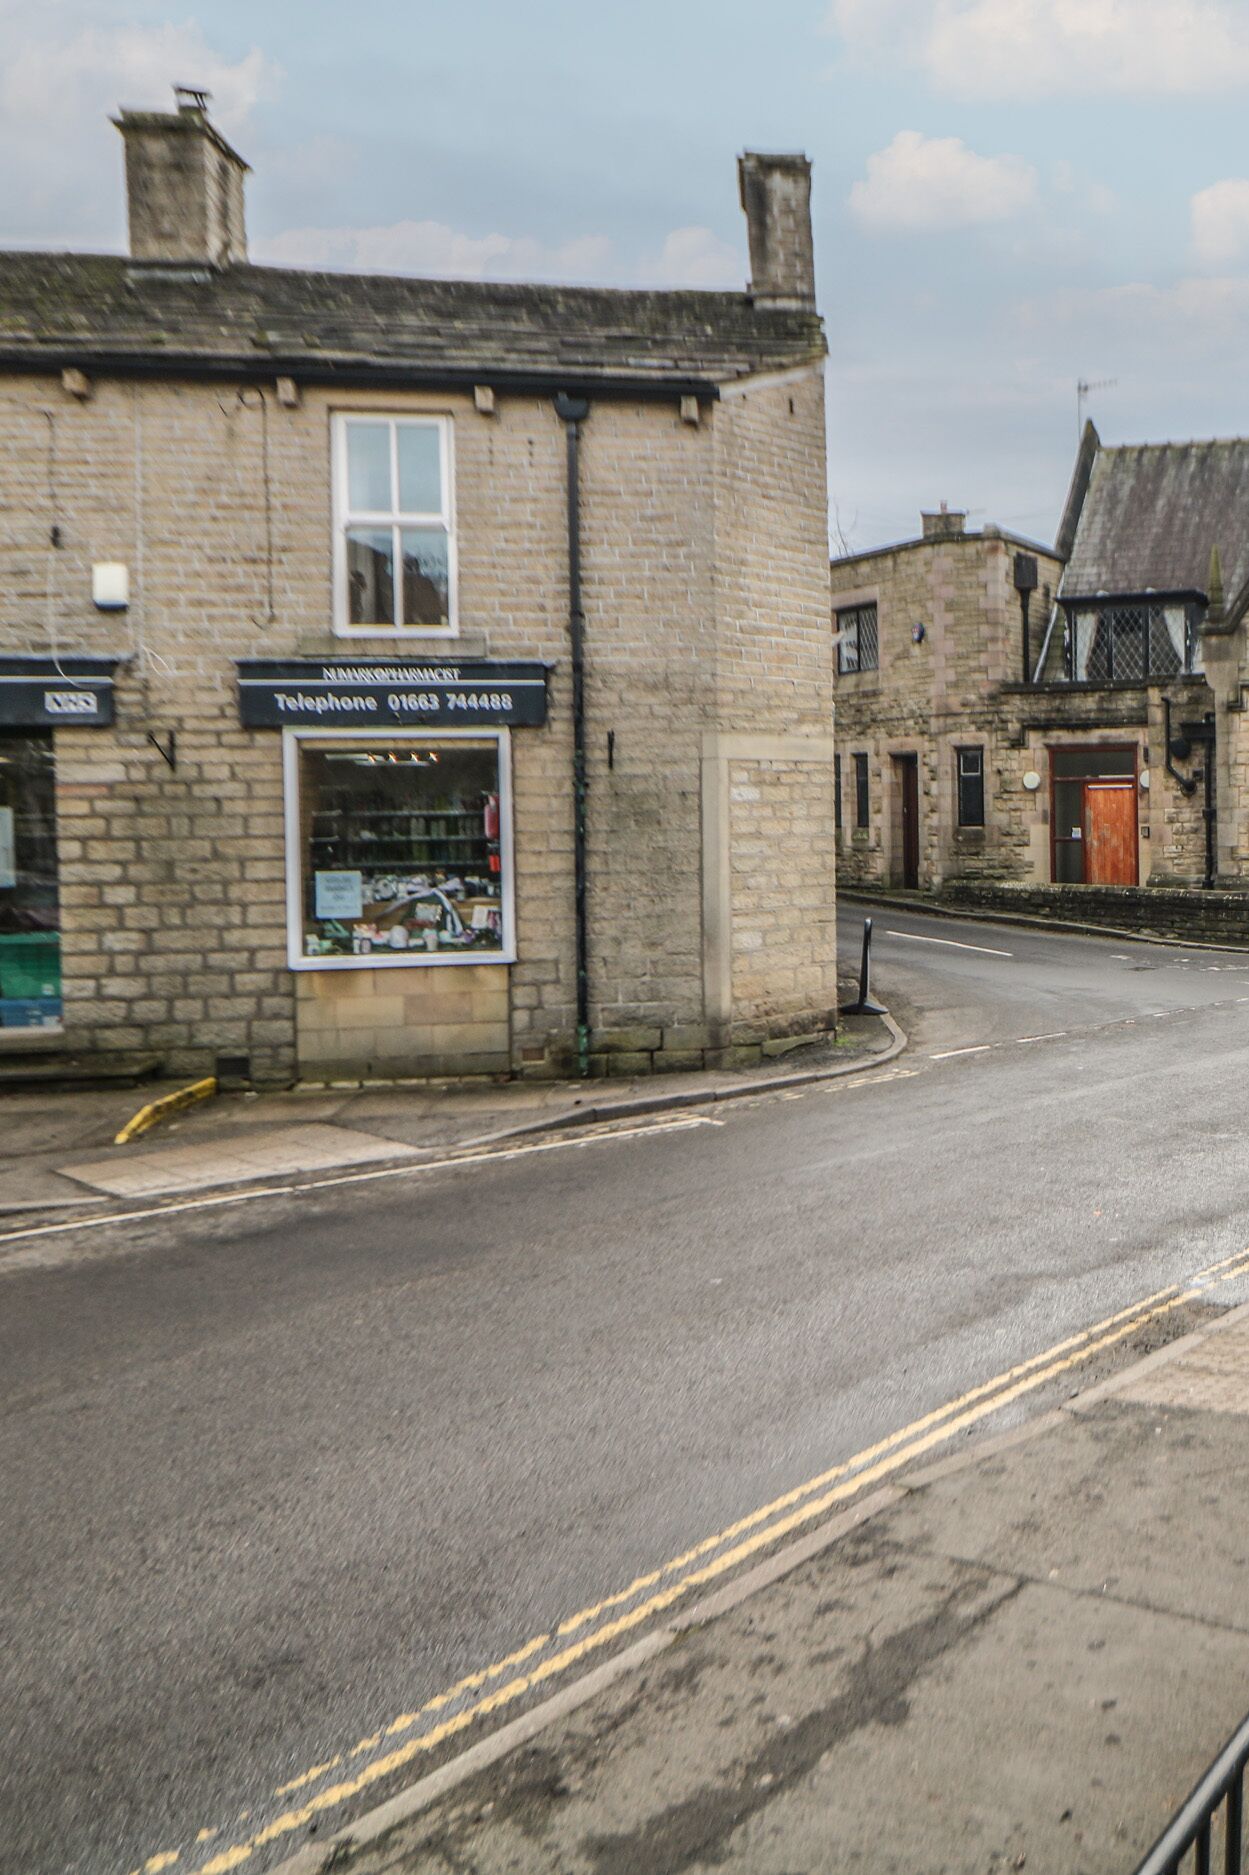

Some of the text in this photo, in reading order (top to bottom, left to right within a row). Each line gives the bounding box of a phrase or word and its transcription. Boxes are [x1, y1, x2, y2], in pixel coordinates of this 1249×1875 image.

[273, 691, 513, 714] Telephone 01663 744488
